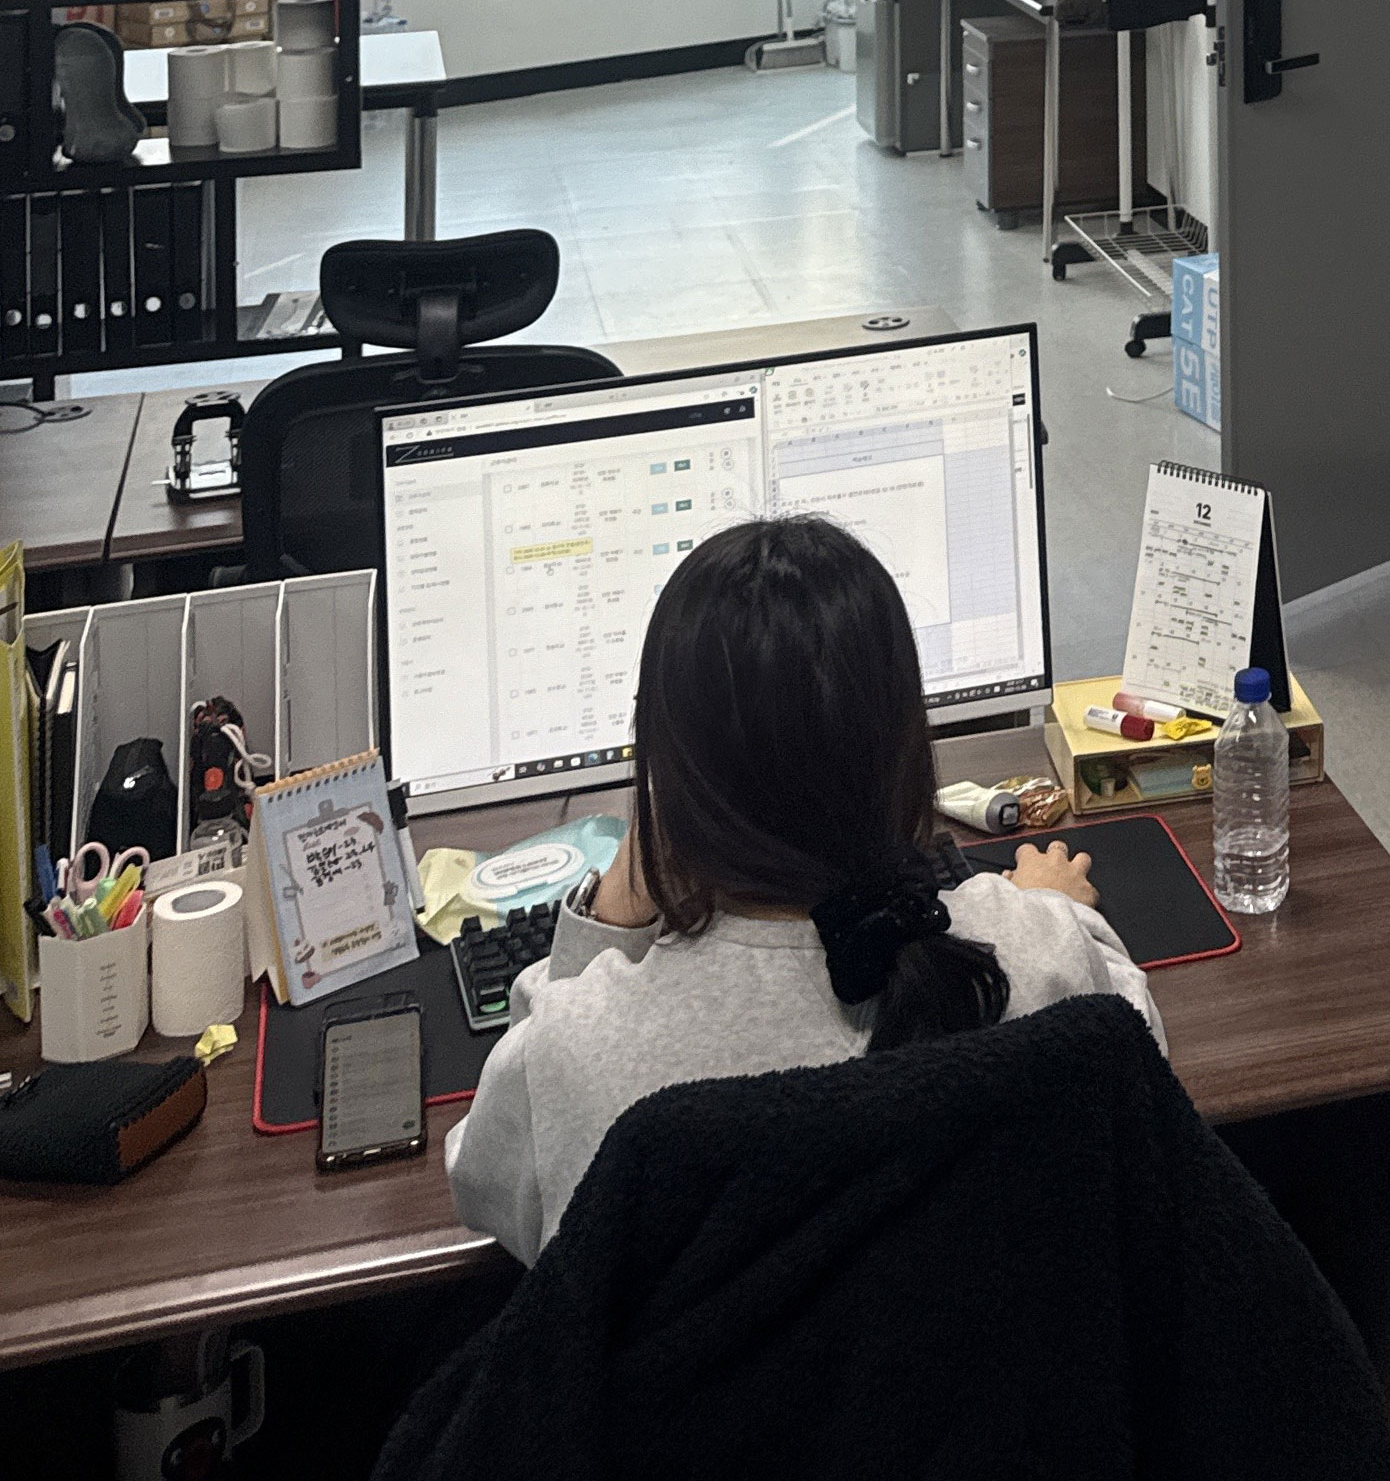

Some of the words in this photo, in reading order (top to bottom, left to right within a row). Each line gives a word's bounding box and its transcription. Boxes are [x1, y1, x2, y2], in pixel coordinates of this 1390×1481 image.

[1181, 274, 1195, 339] CAT
[1207, 287, 1219, 349] UTP
[1195, 502, 1212, 520] 12
